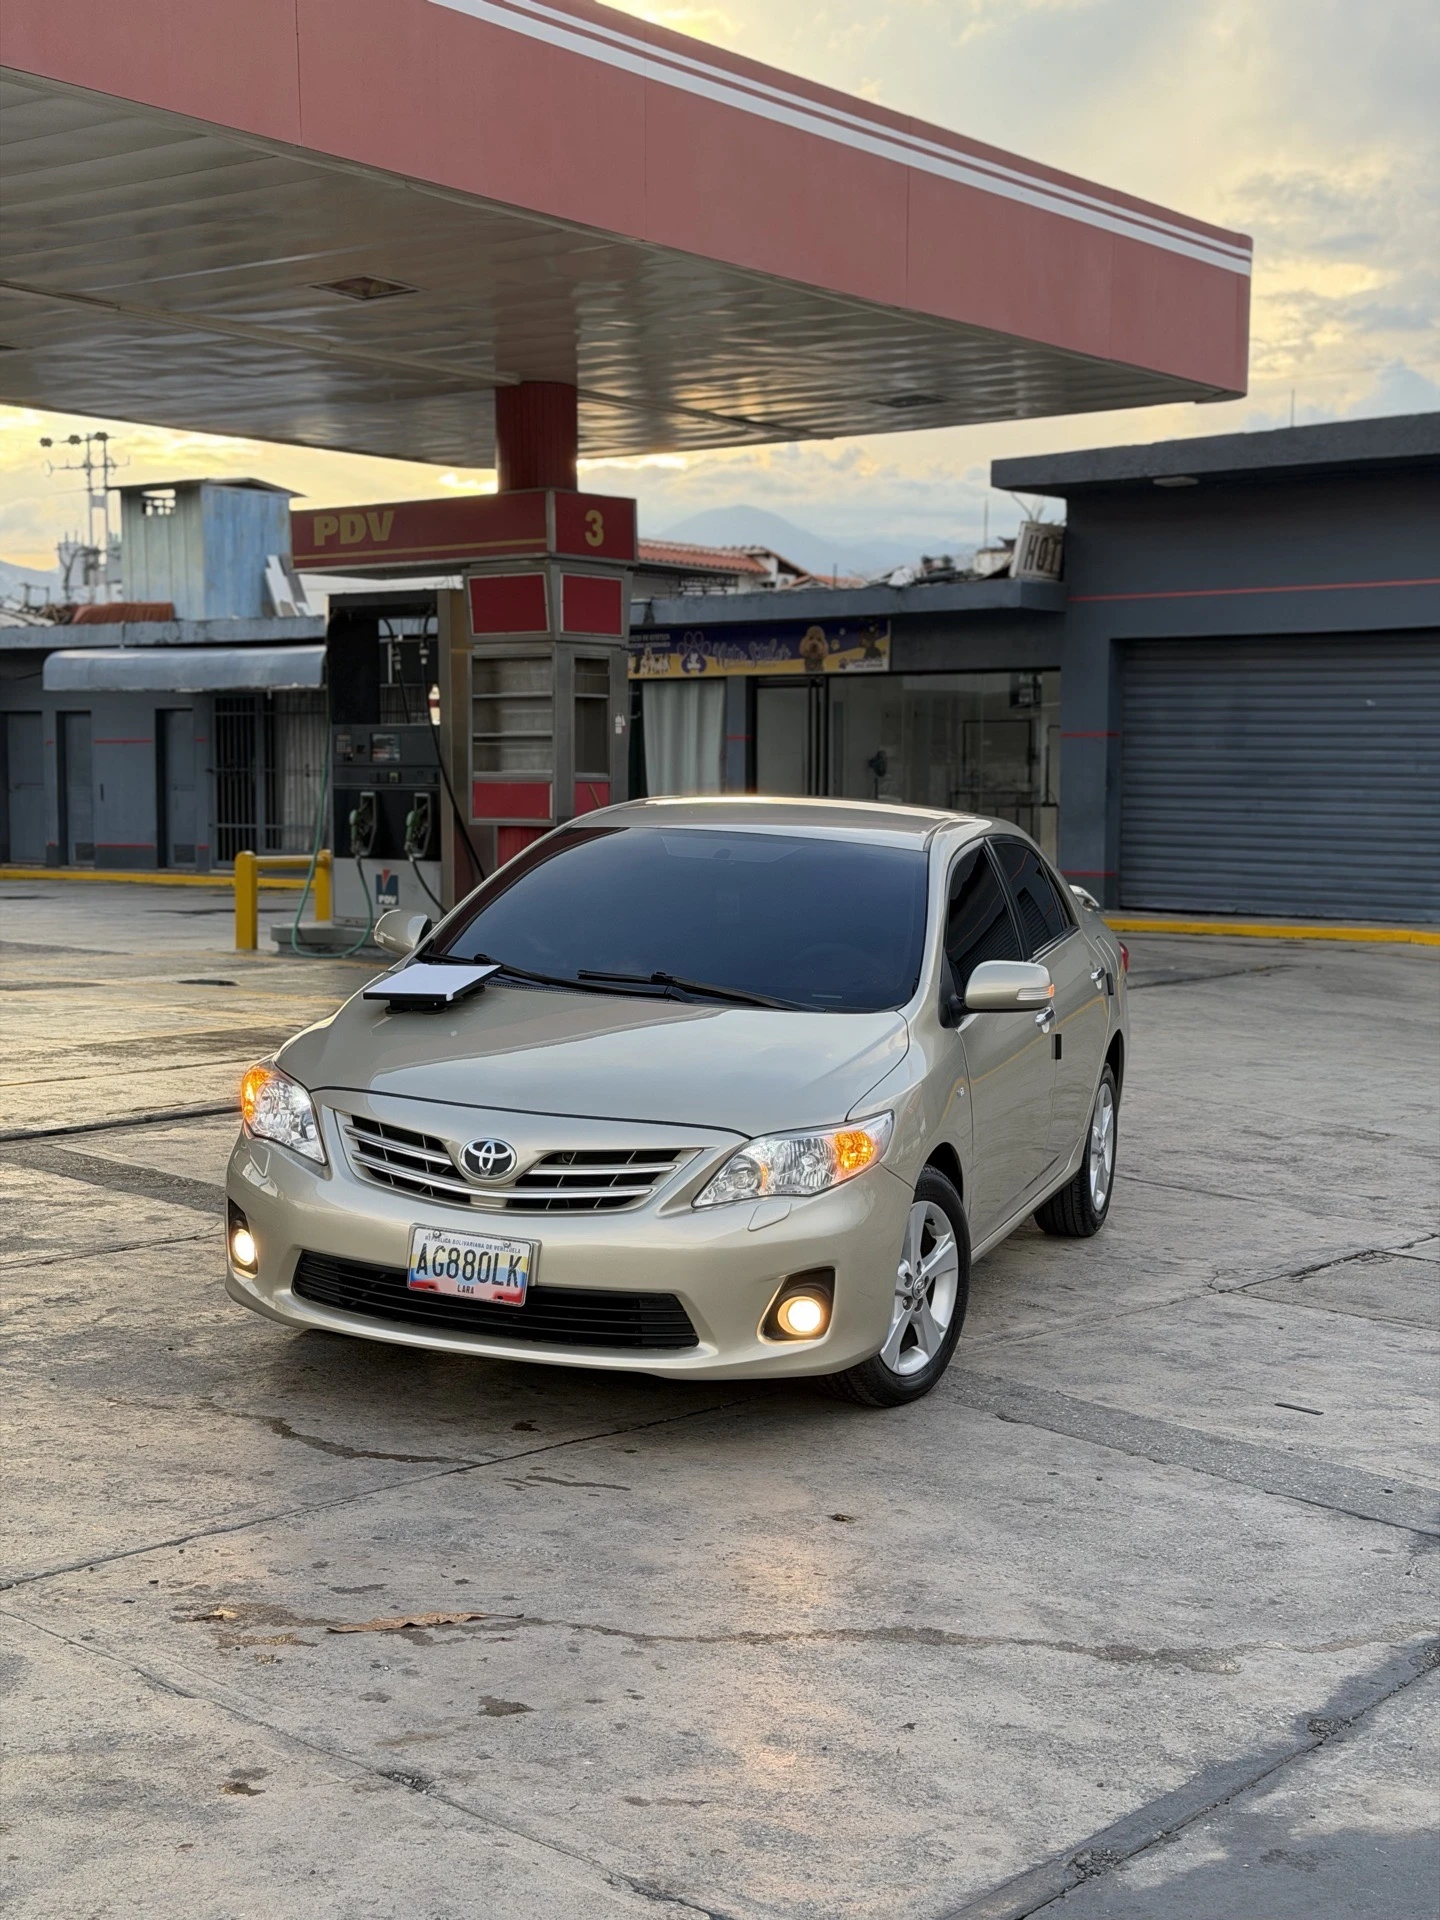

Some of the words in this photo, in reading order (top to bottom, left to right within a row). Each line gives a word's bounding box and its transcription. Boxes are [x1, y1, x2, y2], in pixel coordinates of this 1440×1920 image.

[313, 510, 395, 546] PDV
[585, 509, 605, 547] 3
[378, 894, 397, 904] PDV
[415, 1243, 523, 1288] AG880LK
[457, 1284, 475, 1295] LARA
